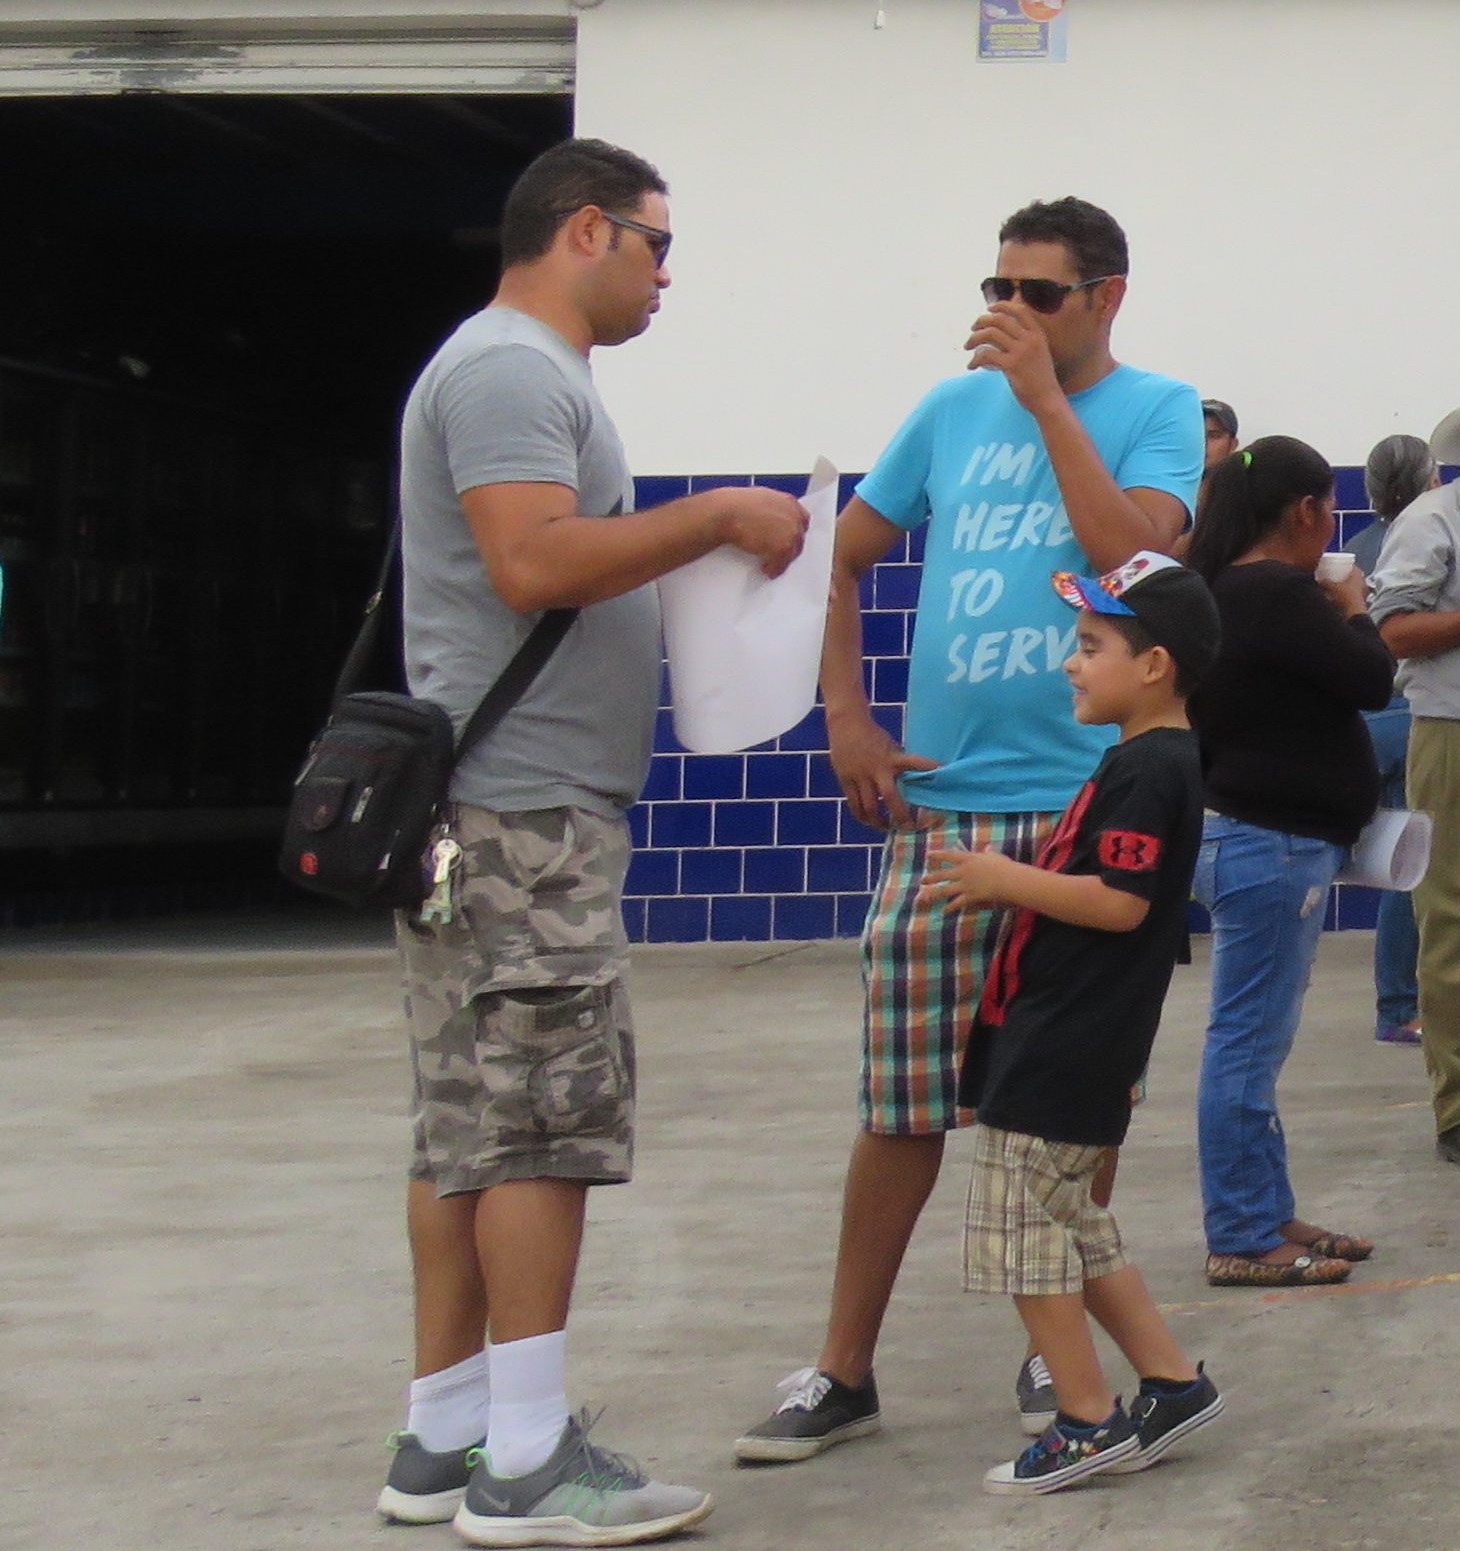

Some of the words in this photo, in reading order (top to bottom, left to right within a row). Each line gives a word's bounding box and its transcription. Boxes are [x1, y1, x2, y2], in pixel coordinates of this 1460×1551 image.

[959, 442, 1037, 488] I'M
[953, 500, 1075, 552] HERE
[946, 568, 1005, 624] TO
[947, 625, 1081, 683] SERV
